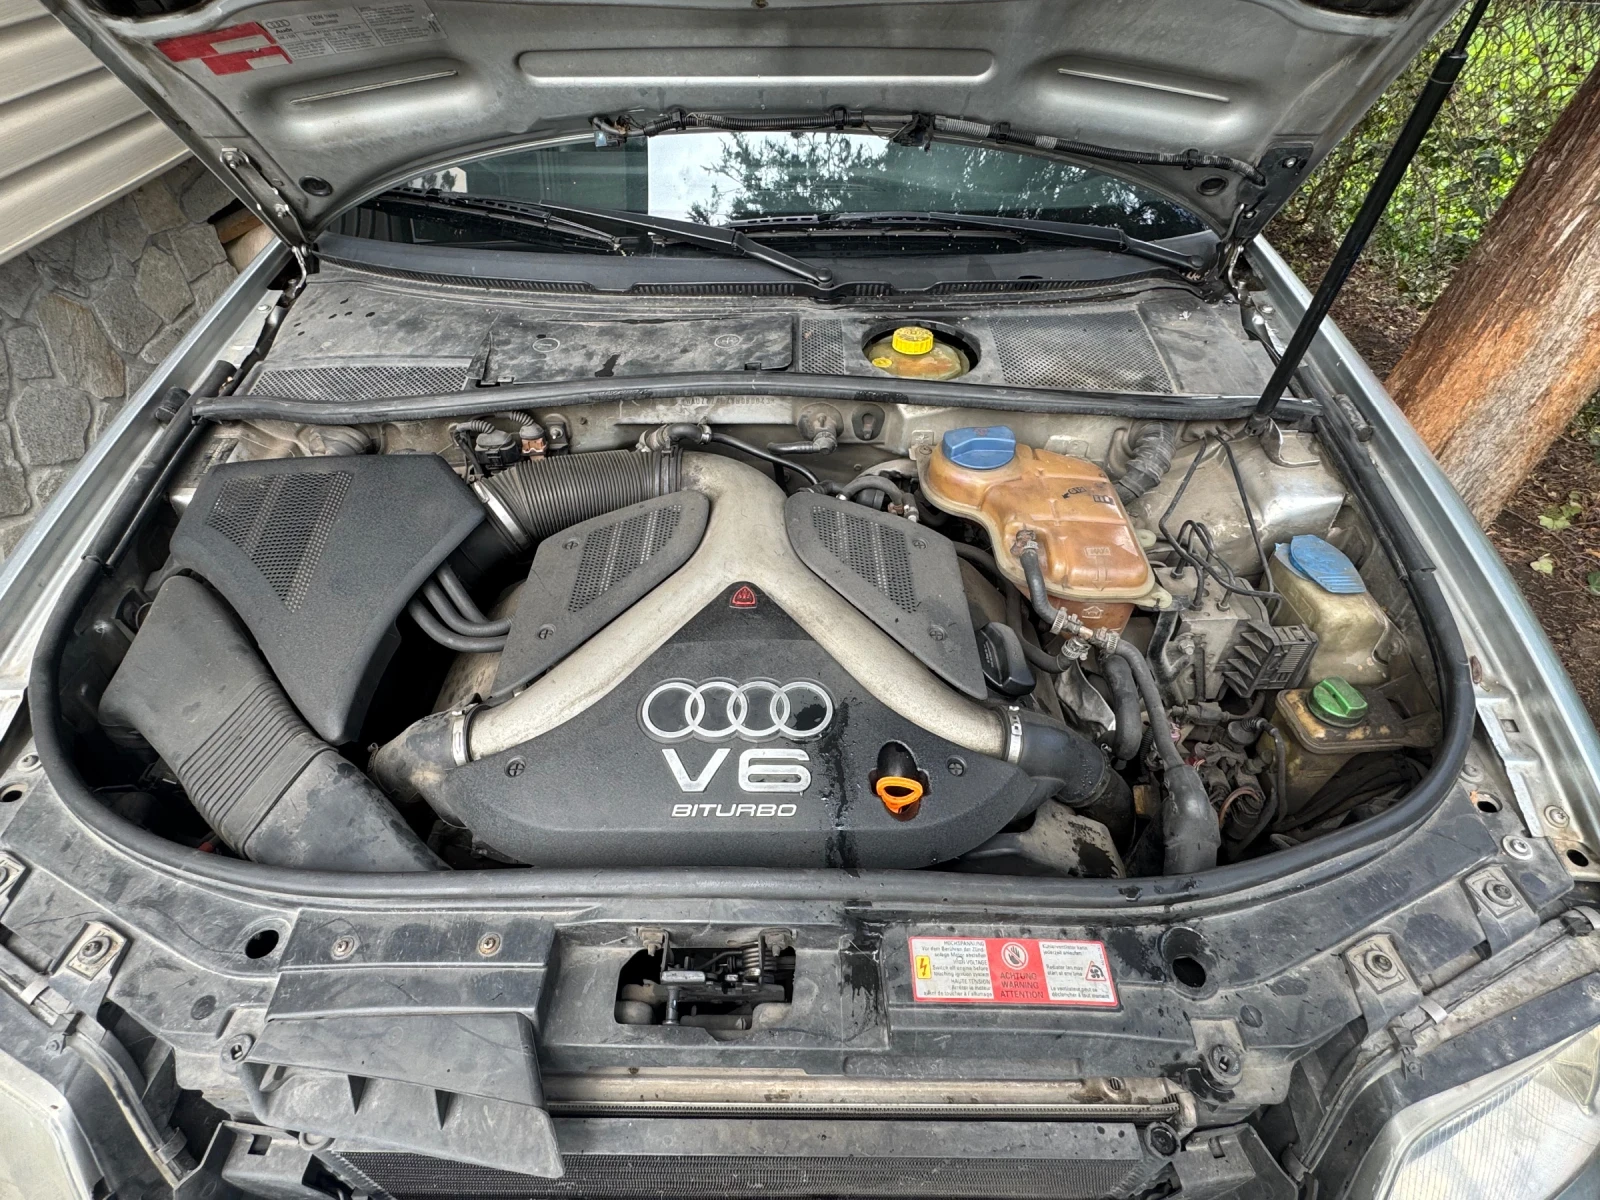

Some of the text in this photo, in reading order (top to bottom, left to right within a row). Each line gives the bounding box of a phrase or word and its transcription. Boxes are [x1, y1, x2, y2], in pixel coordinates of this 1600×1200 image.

[661, 748, 812, 793] V6
[671, 803, 797, 817] BITURBO
[1001, 981, 1039, 989] WARNING
[1000, 990, 1043, 999] ATTENTION
